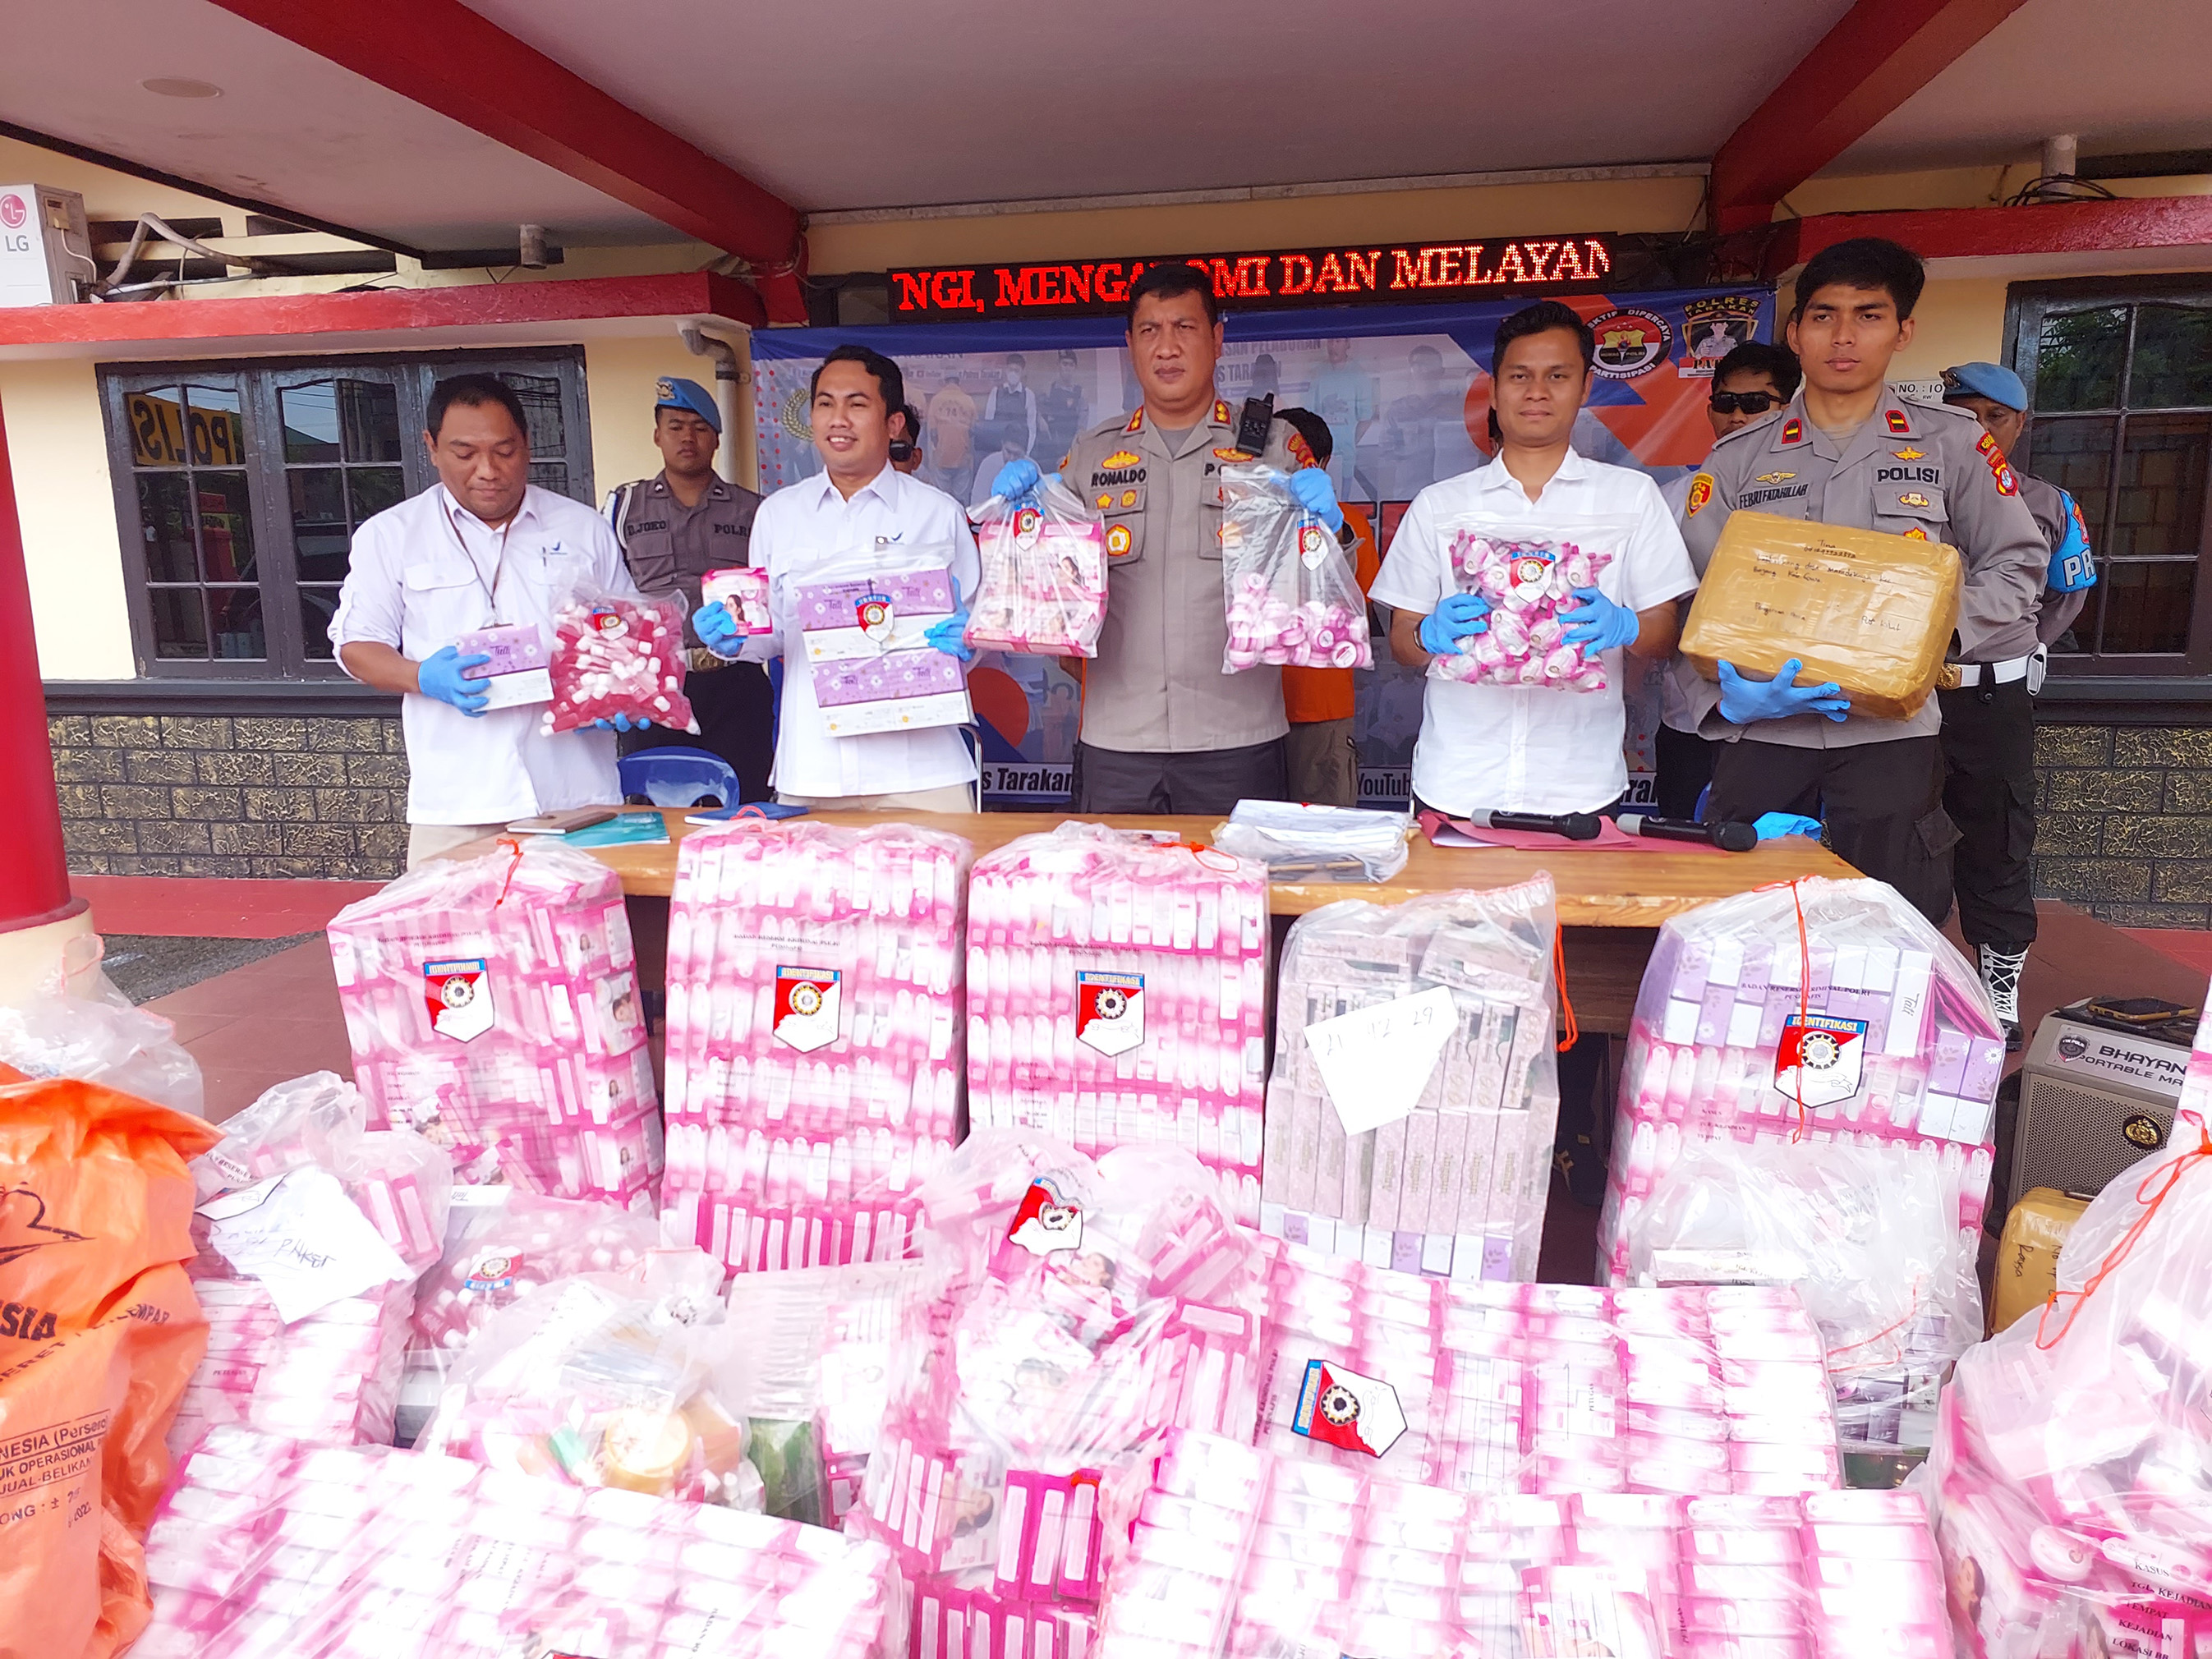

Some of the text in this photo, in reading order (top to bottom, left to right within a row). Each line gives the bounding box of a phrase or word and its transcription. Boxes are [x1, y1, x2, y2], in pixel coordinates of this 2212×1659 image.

[5, 235, 30, 252] LG
[892, 240, 1610, 312] NGI, MENGAMI DAN MELAYAN
[1685, 296, 1759, 312] POLRES
[1688, 305, 1755, 316] TARAKAN
[1627, 309, 1671, 342] DIPERCAYA
[1589, 362, 1656, 379] PARTISIPASI
[1091, 468, 1147, 488] RONALDO
[1877, 467, 1940, 485] POLISI
[1740, 491, 1762, 509] FEBRI
[1806, 986, 1844, 995] RIMINAL
[2079, 1055, 2155, 1078] PORTABLE
[0, 1302, 57, 1341] SIA
[0, 1340, 66, 1382] ERET
[0, 1415, 108, 1460] NESIA (Persero
[19, 1440, 96, 1475] OPERASIONAL
[2135, 1561, 2169, 1577] KASUS
[2158, 1588, 2212, 1611] KEJADIAN
[2126, 1601, 2169, 1619] TEMPAT
[2118, 1619, 2173, 1642] KEJADIAN
[2112, 1638, 2153, 1657] LOKASI
